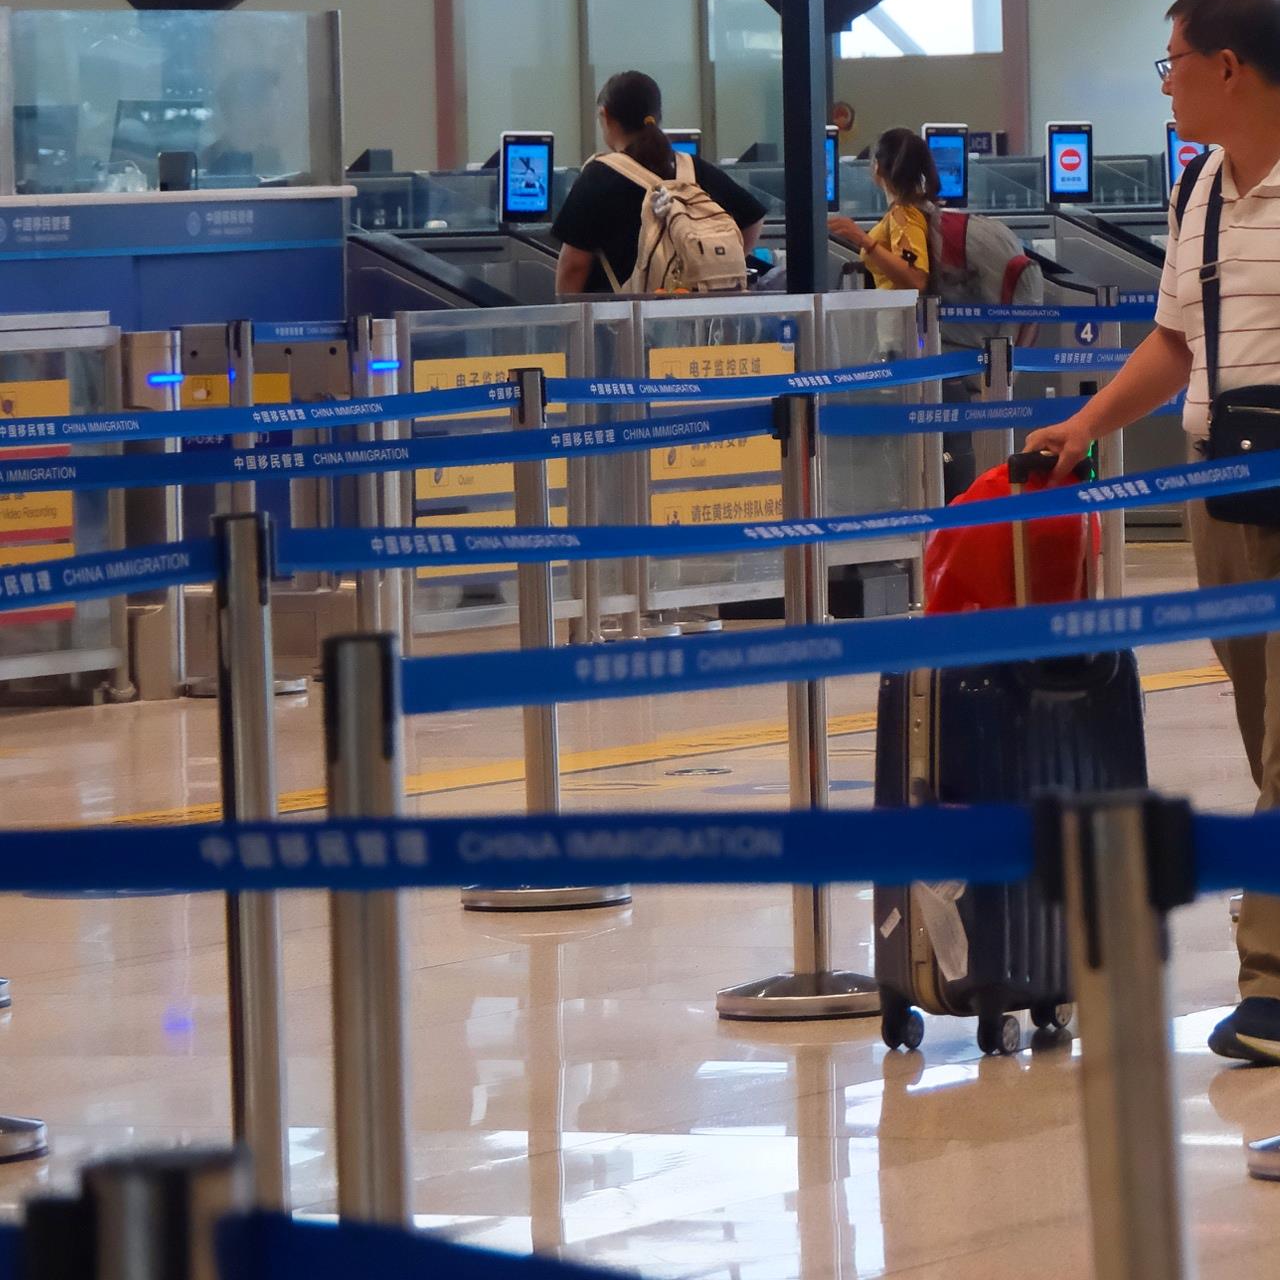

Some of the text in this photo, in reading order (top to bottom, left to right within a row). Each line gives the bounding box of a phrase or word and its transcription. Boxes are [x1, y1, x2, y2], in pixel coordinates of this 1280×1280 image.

[987, 308, 1010, 317] CHINA
[1080, 323, 1093, 342] 4
[689, 358, 761, 377] 电子监控区域
[253, 408, 306, 423] 中国移民管理
[311, 403, 383, 419] CHINA IMMIGRATION
[62, 420, 140, 434] CHINA IMMIGRATION
[623, 421, 710, 440] CHINA IMMIGRATION
[551, 429, 615, 448] 中国移民管理
[234, 453, 304, 471] 中国移民管理
[313, 448, 409, 465] CHINA IMMIGRATION
[6, 467, 76, 482] IMMIGRATION
[371, 535, 457, 554] 中国移民管理
[63, 553, 190, 586] CHINA IMMIGRATION
[0, 570, 52, 596] 民管理
